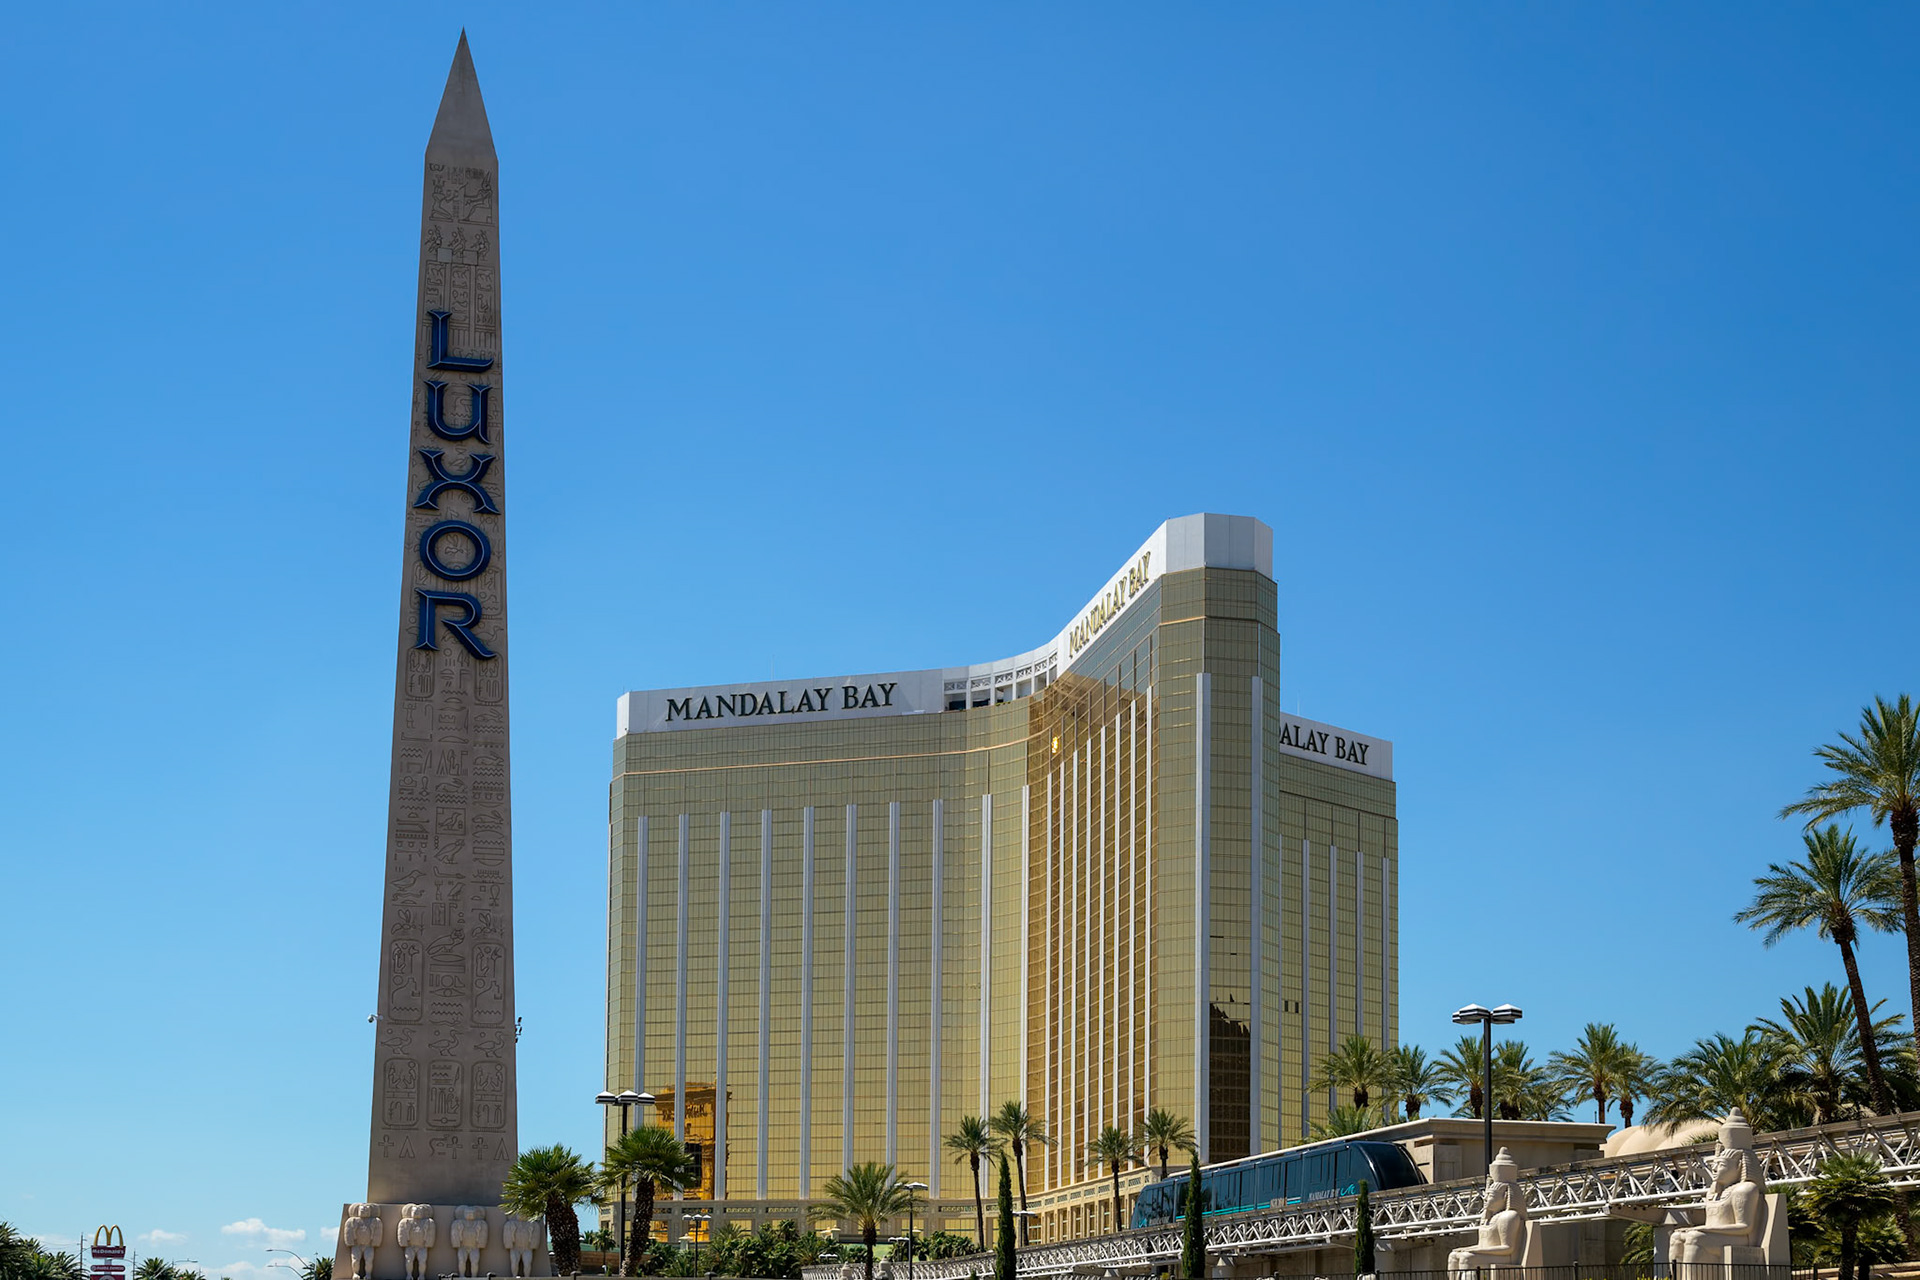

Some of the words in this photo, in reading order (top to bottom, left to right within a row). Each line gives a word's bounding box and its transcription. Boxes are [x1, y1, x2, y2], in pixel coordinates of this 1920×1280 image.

[413, 309, 501, 660] LUXOR
[1069, 575, 1127, 659] MANDALAY
[1128, 550, 1151, 599] BAY
[666, 688, 833, 721] MANDALAY
[842, 683, 898, 710] BAY
[1279, 722, 1330, 755] ALAY
[1334, 736, 1370, 766] BAY
